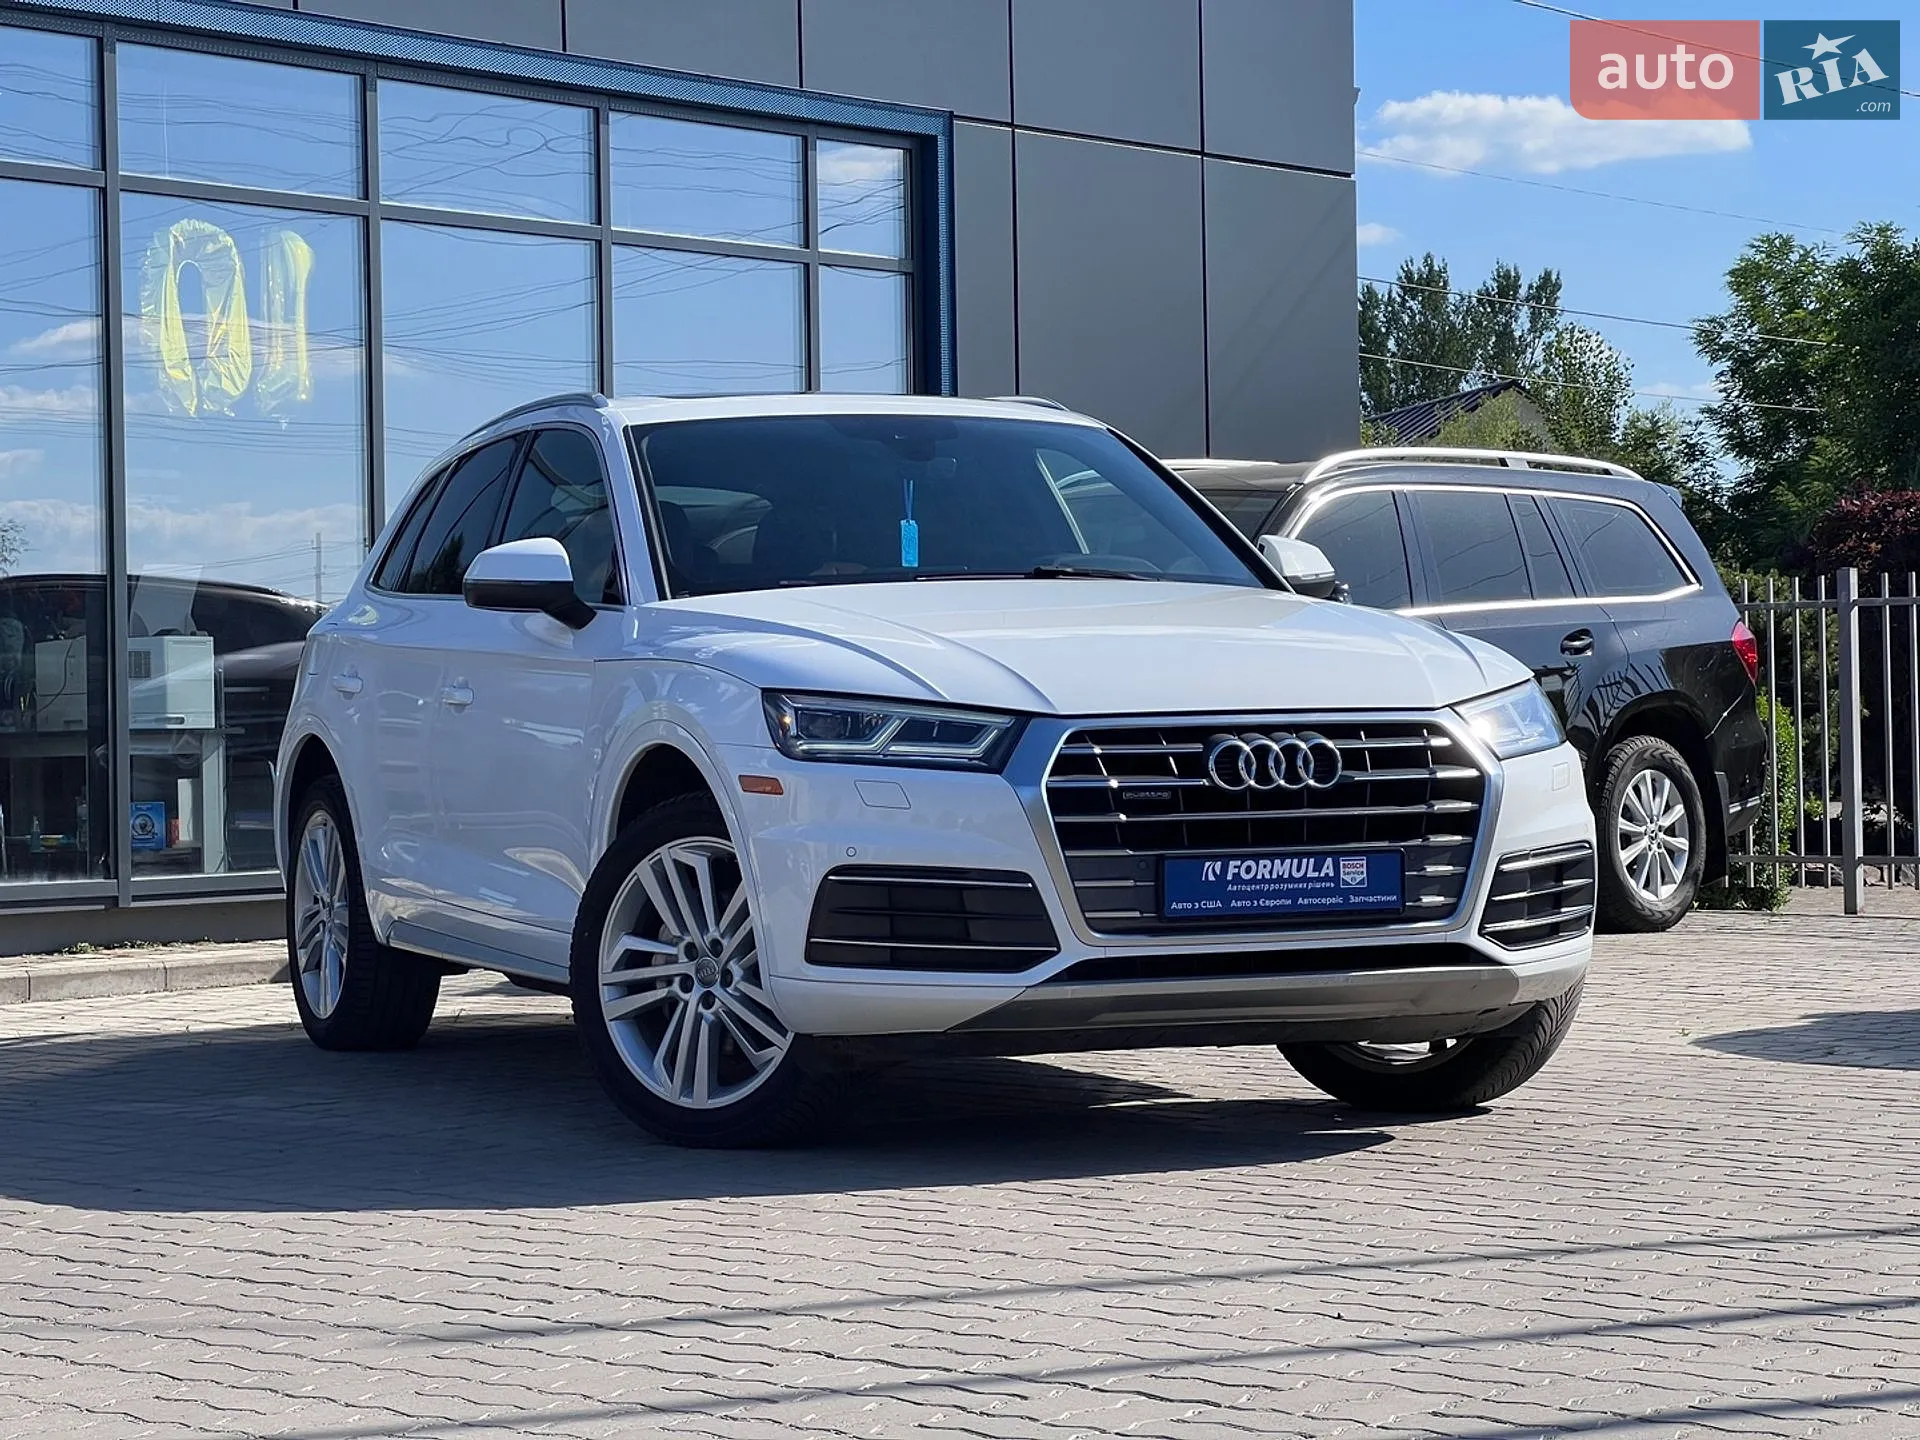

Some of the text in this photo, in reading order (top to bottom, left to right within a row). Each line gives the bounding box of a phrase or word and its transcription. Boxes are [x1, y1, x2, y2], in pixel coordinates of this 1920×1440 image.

[1226, 857, 1335, 880] FORMULA
[1342, 862, 1364, 870] BOSCH
[1226, 883, 1269, 892] Автоцентр
[1170, 901, 1193, 909] Авто
[1200, 899, 1223, 908] США
[1230, 899, 1252, 907] Авто
[1297, 895, 1344, 905] Автосервіс
[1349, 894, 1398, 903] Запчастини
